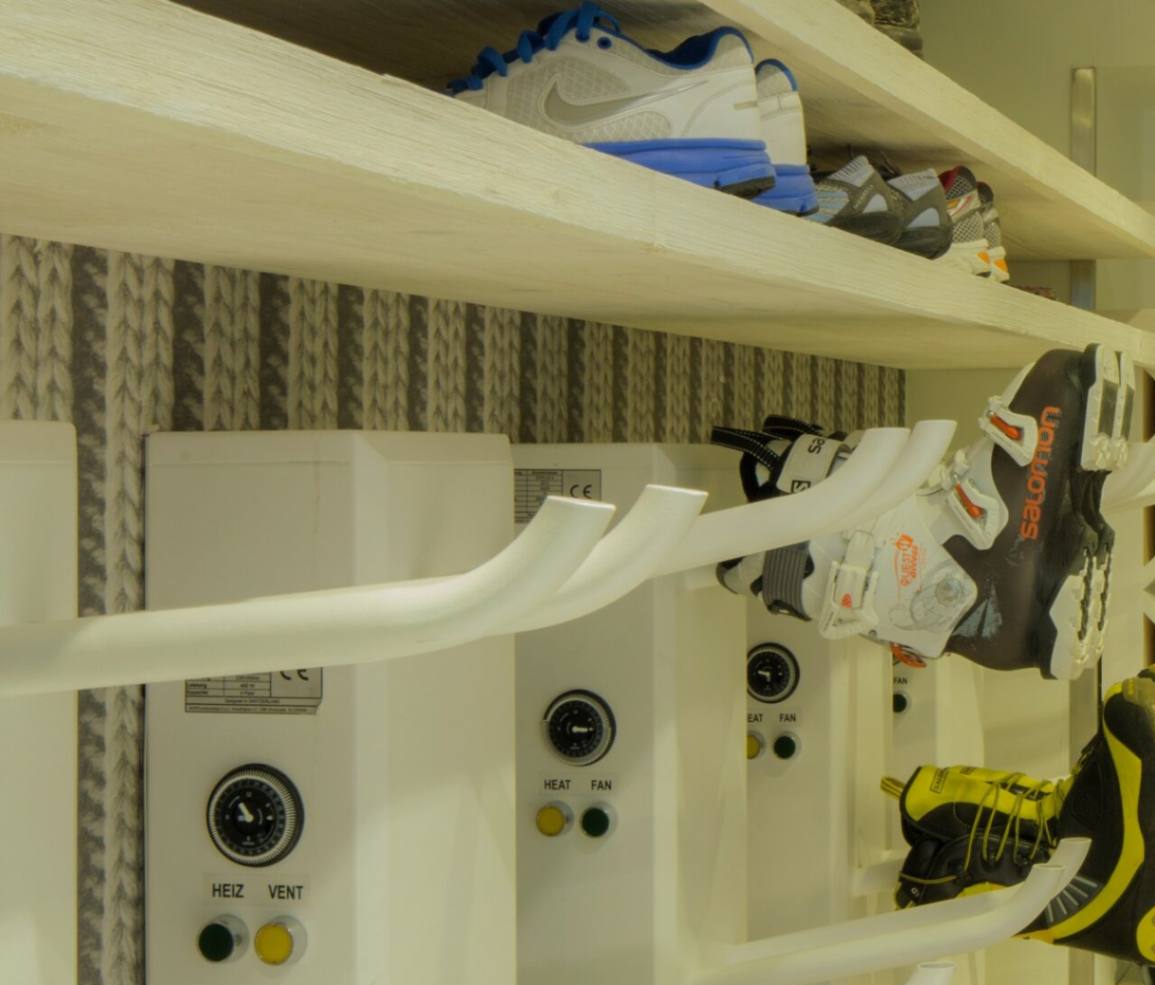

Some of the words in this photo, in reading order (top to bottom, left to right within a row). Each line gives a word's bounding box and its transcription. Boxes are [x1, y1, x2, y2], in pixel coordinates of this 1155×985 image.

[747, 713, 763, 723] EAT
[779, 713, 797, 722] FAN
[544, 779, 571, 790] HEAT
[591, 780, 612, 790] FAN
[212, 883, 244, 898] HEIZ
[268, 885, 303, 899] VENT
